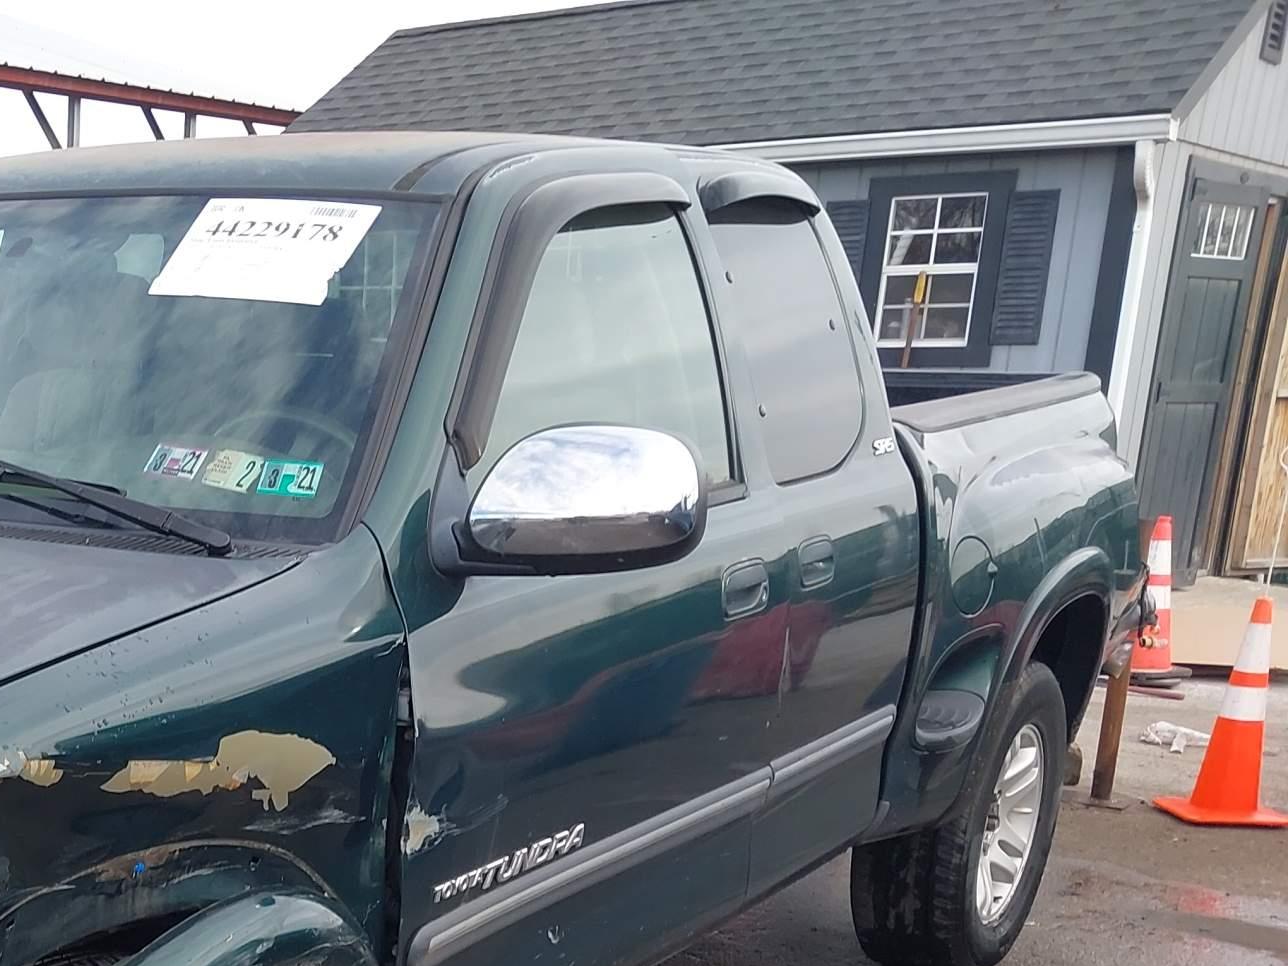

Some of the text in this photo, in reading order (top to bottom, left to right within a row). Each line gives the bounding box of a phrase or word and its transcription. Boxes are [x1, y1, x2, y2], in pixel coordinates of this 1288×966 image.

[206, 219, 344, 242] 44229178
[181, 451, 202, 474] 21
[236, 460, 257, 488] 2
[267, 466, 317, 490] 3 21
[433, 822, 586, 904] TOYOTA TUNDRA
